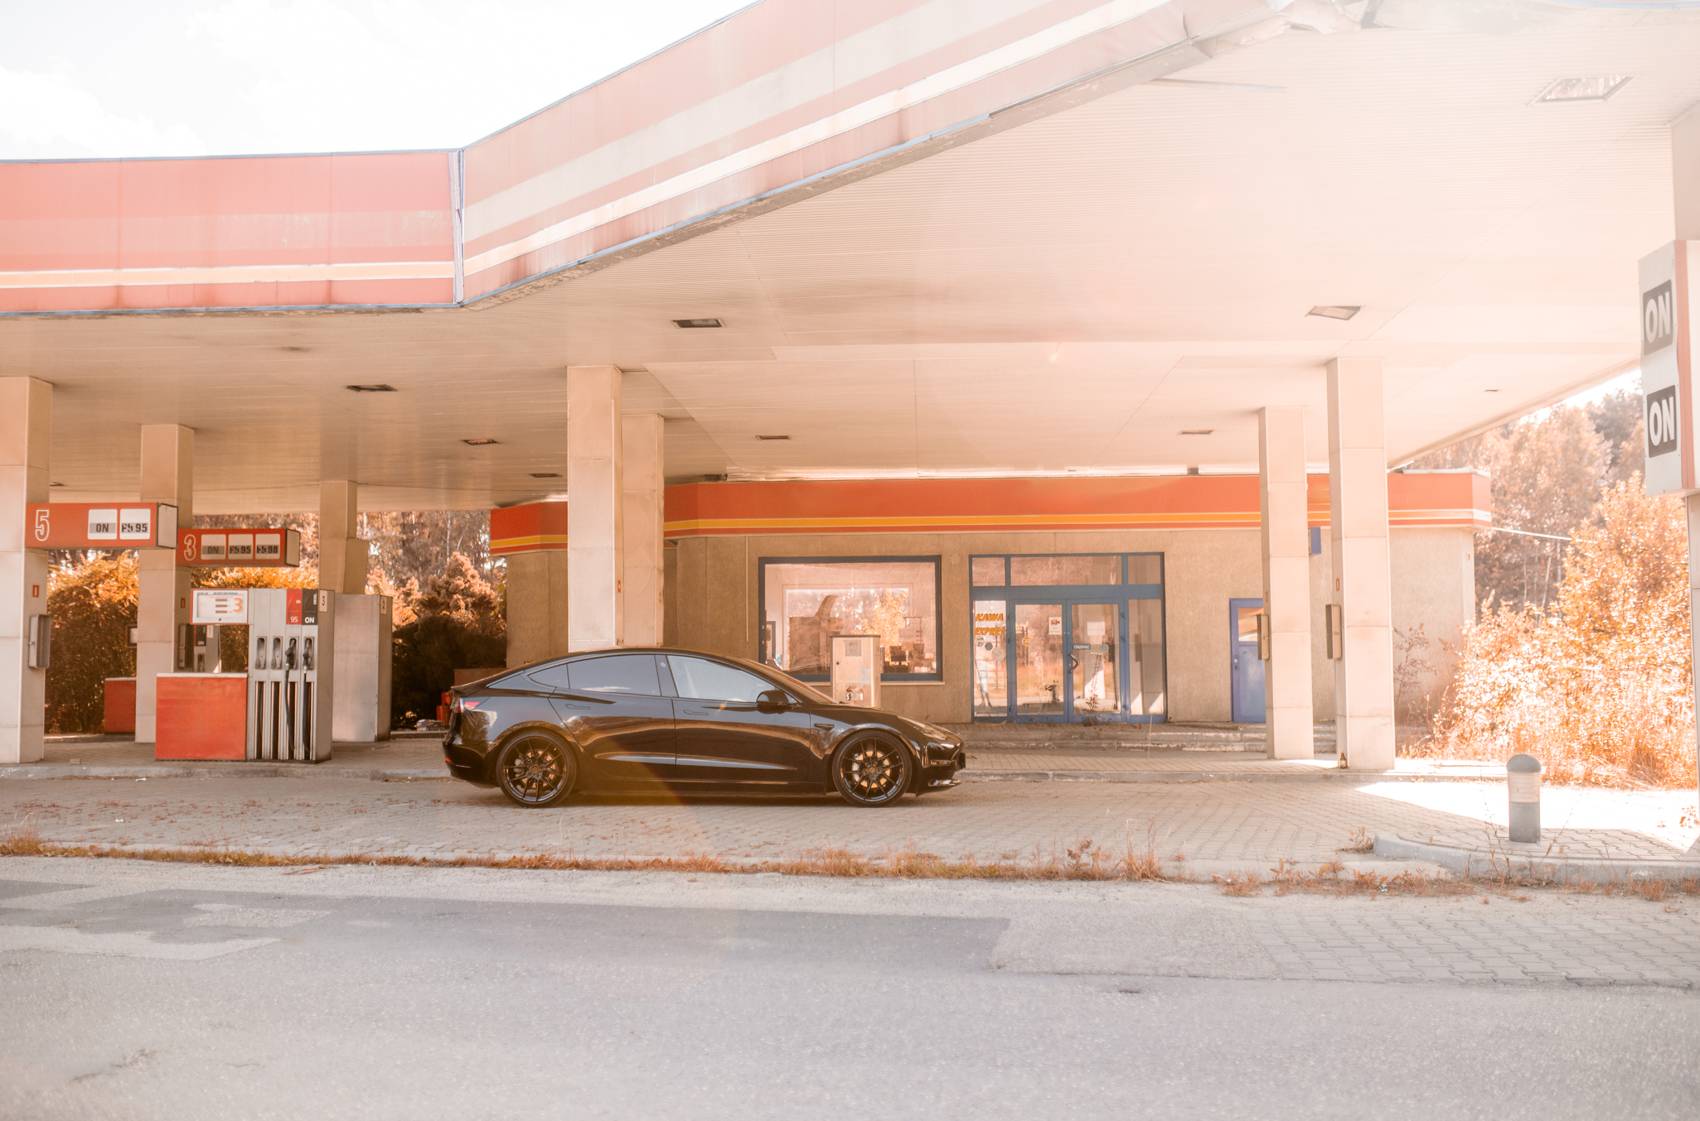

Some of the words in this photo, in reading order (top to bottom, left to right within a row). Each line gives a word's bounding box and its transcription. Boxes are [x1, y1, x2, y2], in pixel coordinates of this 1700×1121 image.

[1645, 291, 1671, 344] ON
[1649, 396, 1675, 447] ON
[35, 509, 50, 542] 5
[95, 523, 109, 533] ON
[135, 523, 148, 533] 95
[183, 534, 197, 561] 3
[207, 546, 219, 554] ON
[240, 546, 251, 554] 95
[267, 545, 278, 554] 98
[233, 597, 243, 612] 3
[304, 616, 315, 624] ON
[975, 613, 1004, 622] KAWA
